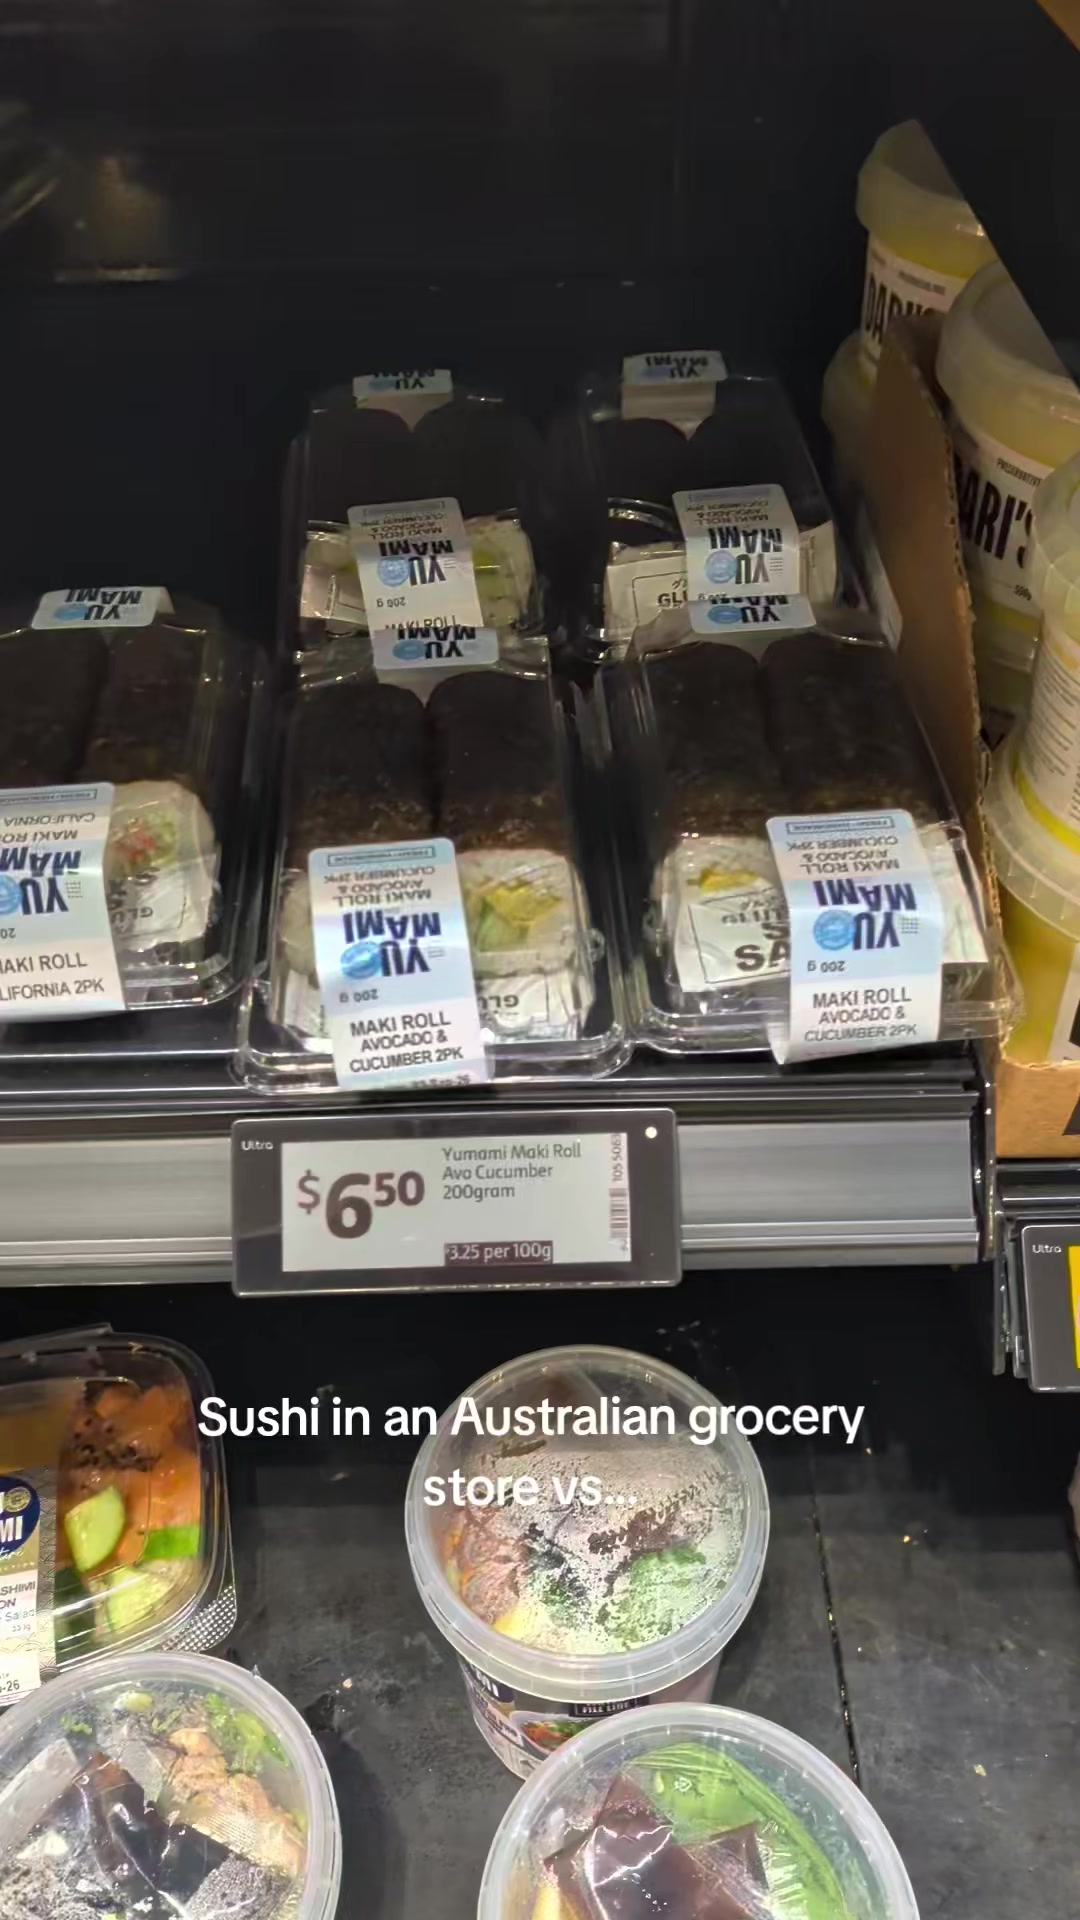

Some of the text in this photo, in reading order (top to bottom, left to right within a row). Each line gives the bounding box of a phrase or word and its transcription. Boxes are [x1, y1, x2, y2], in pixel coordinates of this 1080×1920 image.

[379, 539, 454, 557] MAMI
[707, 526, 782, 554] MAMI
[408, 554, 447, 587] YU
[734, 553, 770, 585] YU
[65, 588, 143, 605] MAMI
[83, 604, 121, 621] YU
[740, 605, 781, 624] YU
[424, 641, 464, 659] YU
[4, 812, 96, 828] CALIFORNIA
[32, 830, 79, 841] MAKI
[817, 835, 898, 849] CUCUMBER
[0, 846, 82, 878] MAM
[818, 849, 889, 861] AVOCADO
[355, 867, 436, 882] CUCUMBER
[799, 858, 900, 875] MAKI ROLL
[18, 877, 69, 916] YU
[351, 880, 424, 894] AVOCADO
[812, 879, 918, 912] MAMI
[332, 889, 432, 907] MAKI ROLL
[0, 927, 16, 939] 20
[342, 910, 442, 944] MAMI
[851, 911, 901, 951] YU
[39, 952, 88, 971] ROLL
[378, 938, 431, 977] YU
[806, 960, 846, 973] 200 g
[0, 978, 105, 1002] LIFORNIA 2PK
[339, 988, 379, 1004] 200 g
[812, 986, 912, 1009] MAKI ROLL
[350, 1010, 452, 1037] MAKI ROLL
[818, 1006, 905, 1025] AVOCADO &
[361, 1029, 449, 1053] AVOCADO &
[804, 1023, 918, 1042] CUCUMBER 2PK
[349, 1046, 464, 1073] CUCUMBER 2PK
[241, 1140, 274, 1151] Ultra
[442, 1142, 582, 1162] Yumami Maki Roll
[442, 1163, 554, 1181] Avo Cucumber
[442, 1184, 515, 1203] 200gram
[484, 1243, 510, 1263] per
[513, 1242, 552, 1262] 100g
[1031, 1244, 1062, 1255] Ultra
[0, 1580, 36, 1597] SHIMI
[0, 1598, 16, 1611] ON
